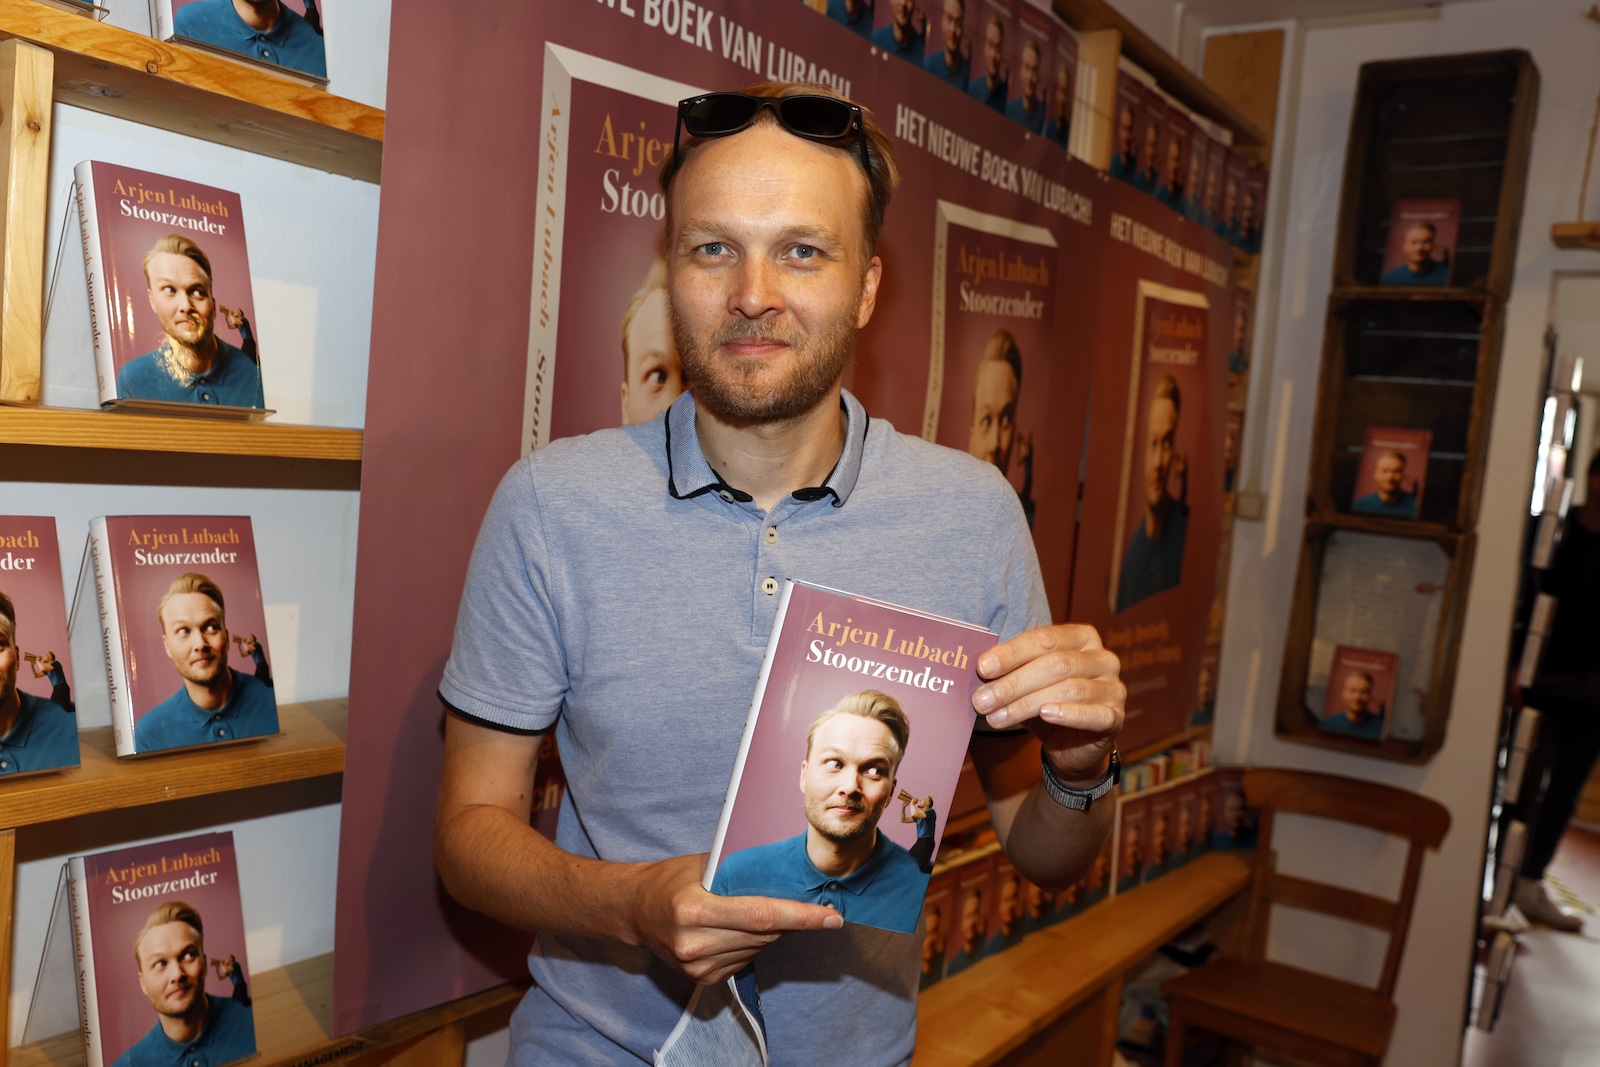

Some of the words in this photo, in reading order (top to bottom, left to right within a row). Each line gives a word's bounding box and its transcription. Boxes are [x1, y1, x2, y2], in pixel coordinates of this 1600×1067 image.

[719, 16, 762, 75] VAN
[895, 103, 926, 148] HET
[927, 121, 981, 176] NIEUWE
[981, 151, 1019, 194] BOEK
[113, 178, 166, 204] Arjen
[169, 189, 229, 218] Lubach
[119, 198, 226, 236] Stoorzender
[957, 244, 997, 286] Arjen
[999, 250, 1049, 287] Lubach
[960, 281, 1045, 319] Stoorzender
[127, 528, 179, 550] Arjen
[181, 528, 240, 545] Lubach
[134, 547, 237, 566] Stoorzender
[805, 611, 879, 648] Arjen
[882, 628, 969, 670] Lubach
[805, 639, 955, 695] Stoorzender
[105, 863, 158, 886] Arjen
[161, 848, 221, 873] Lubach
[112, 870, 218, 904] Stoorzender
